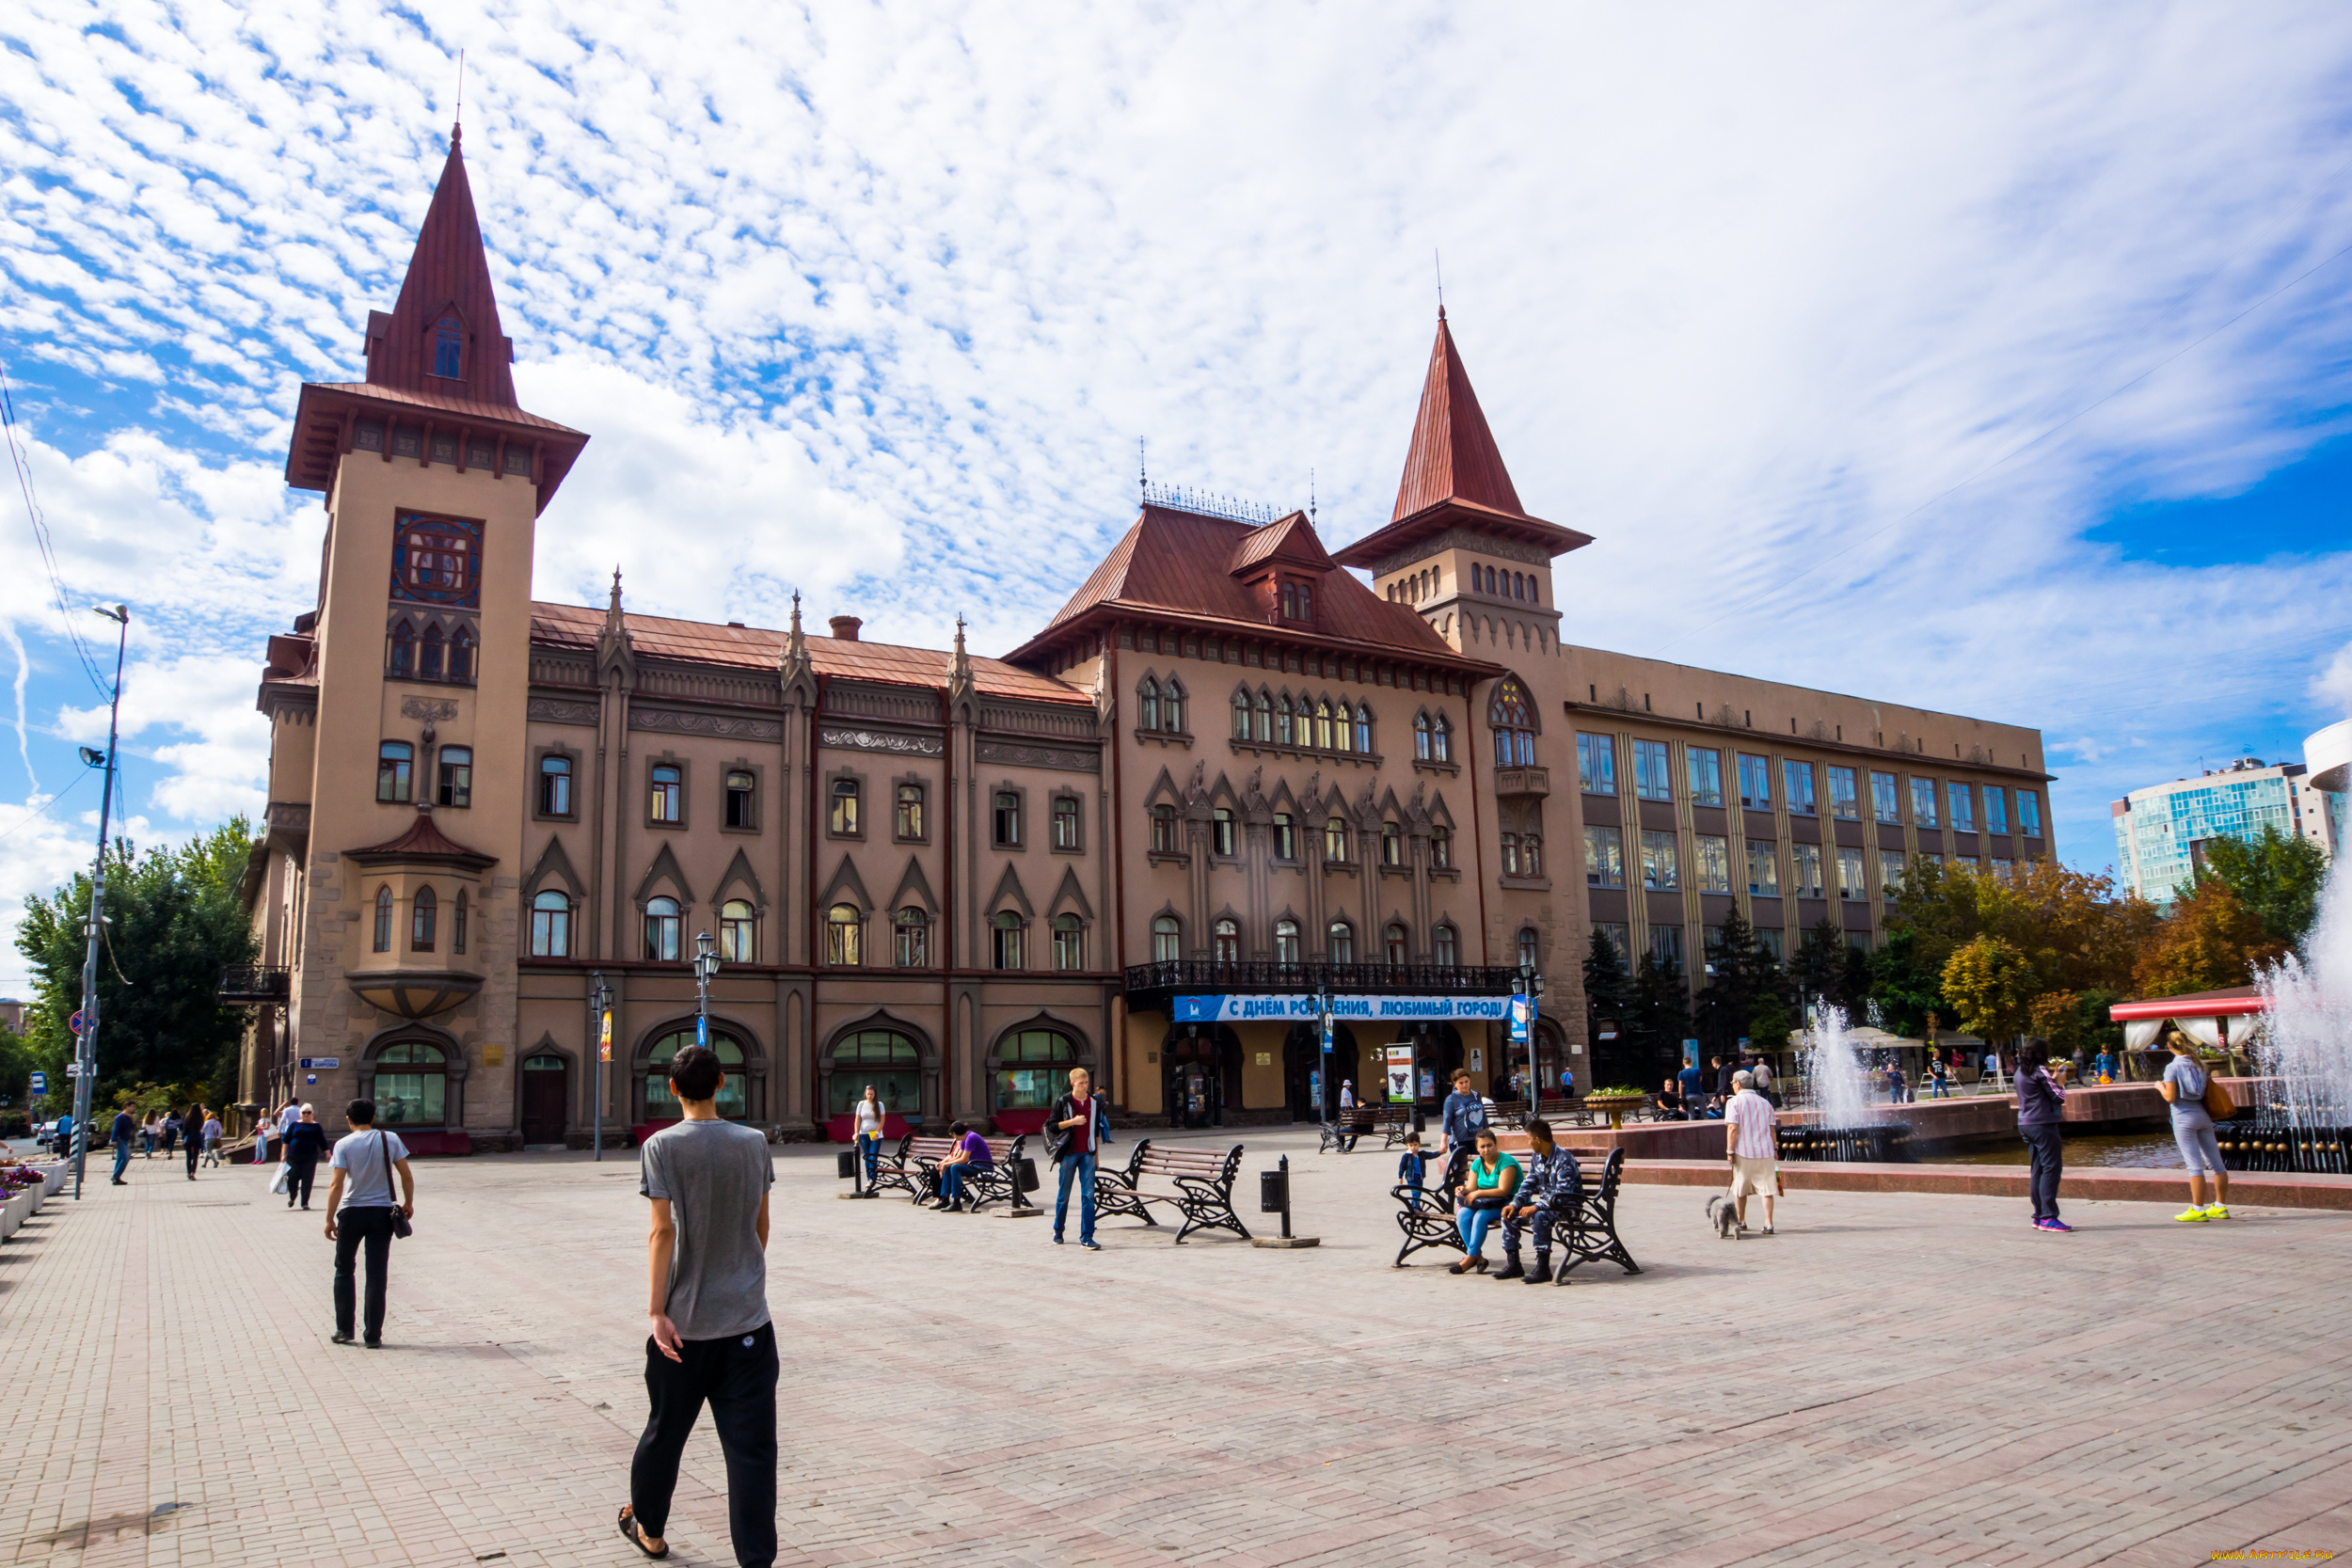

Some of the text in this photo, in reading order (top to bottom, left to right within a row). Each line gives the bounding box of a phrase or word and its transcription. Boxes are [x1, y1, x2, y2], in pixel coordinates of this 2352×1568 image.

[1229, 1000, 1239, 1016] С
[1243, 996, 1286, 1018] ДНЁМ
[1379, 998, 1454, 1016] ЛЮБИМЫЙ
[1456, 1002, 1502, 1017] ГОРОД!
